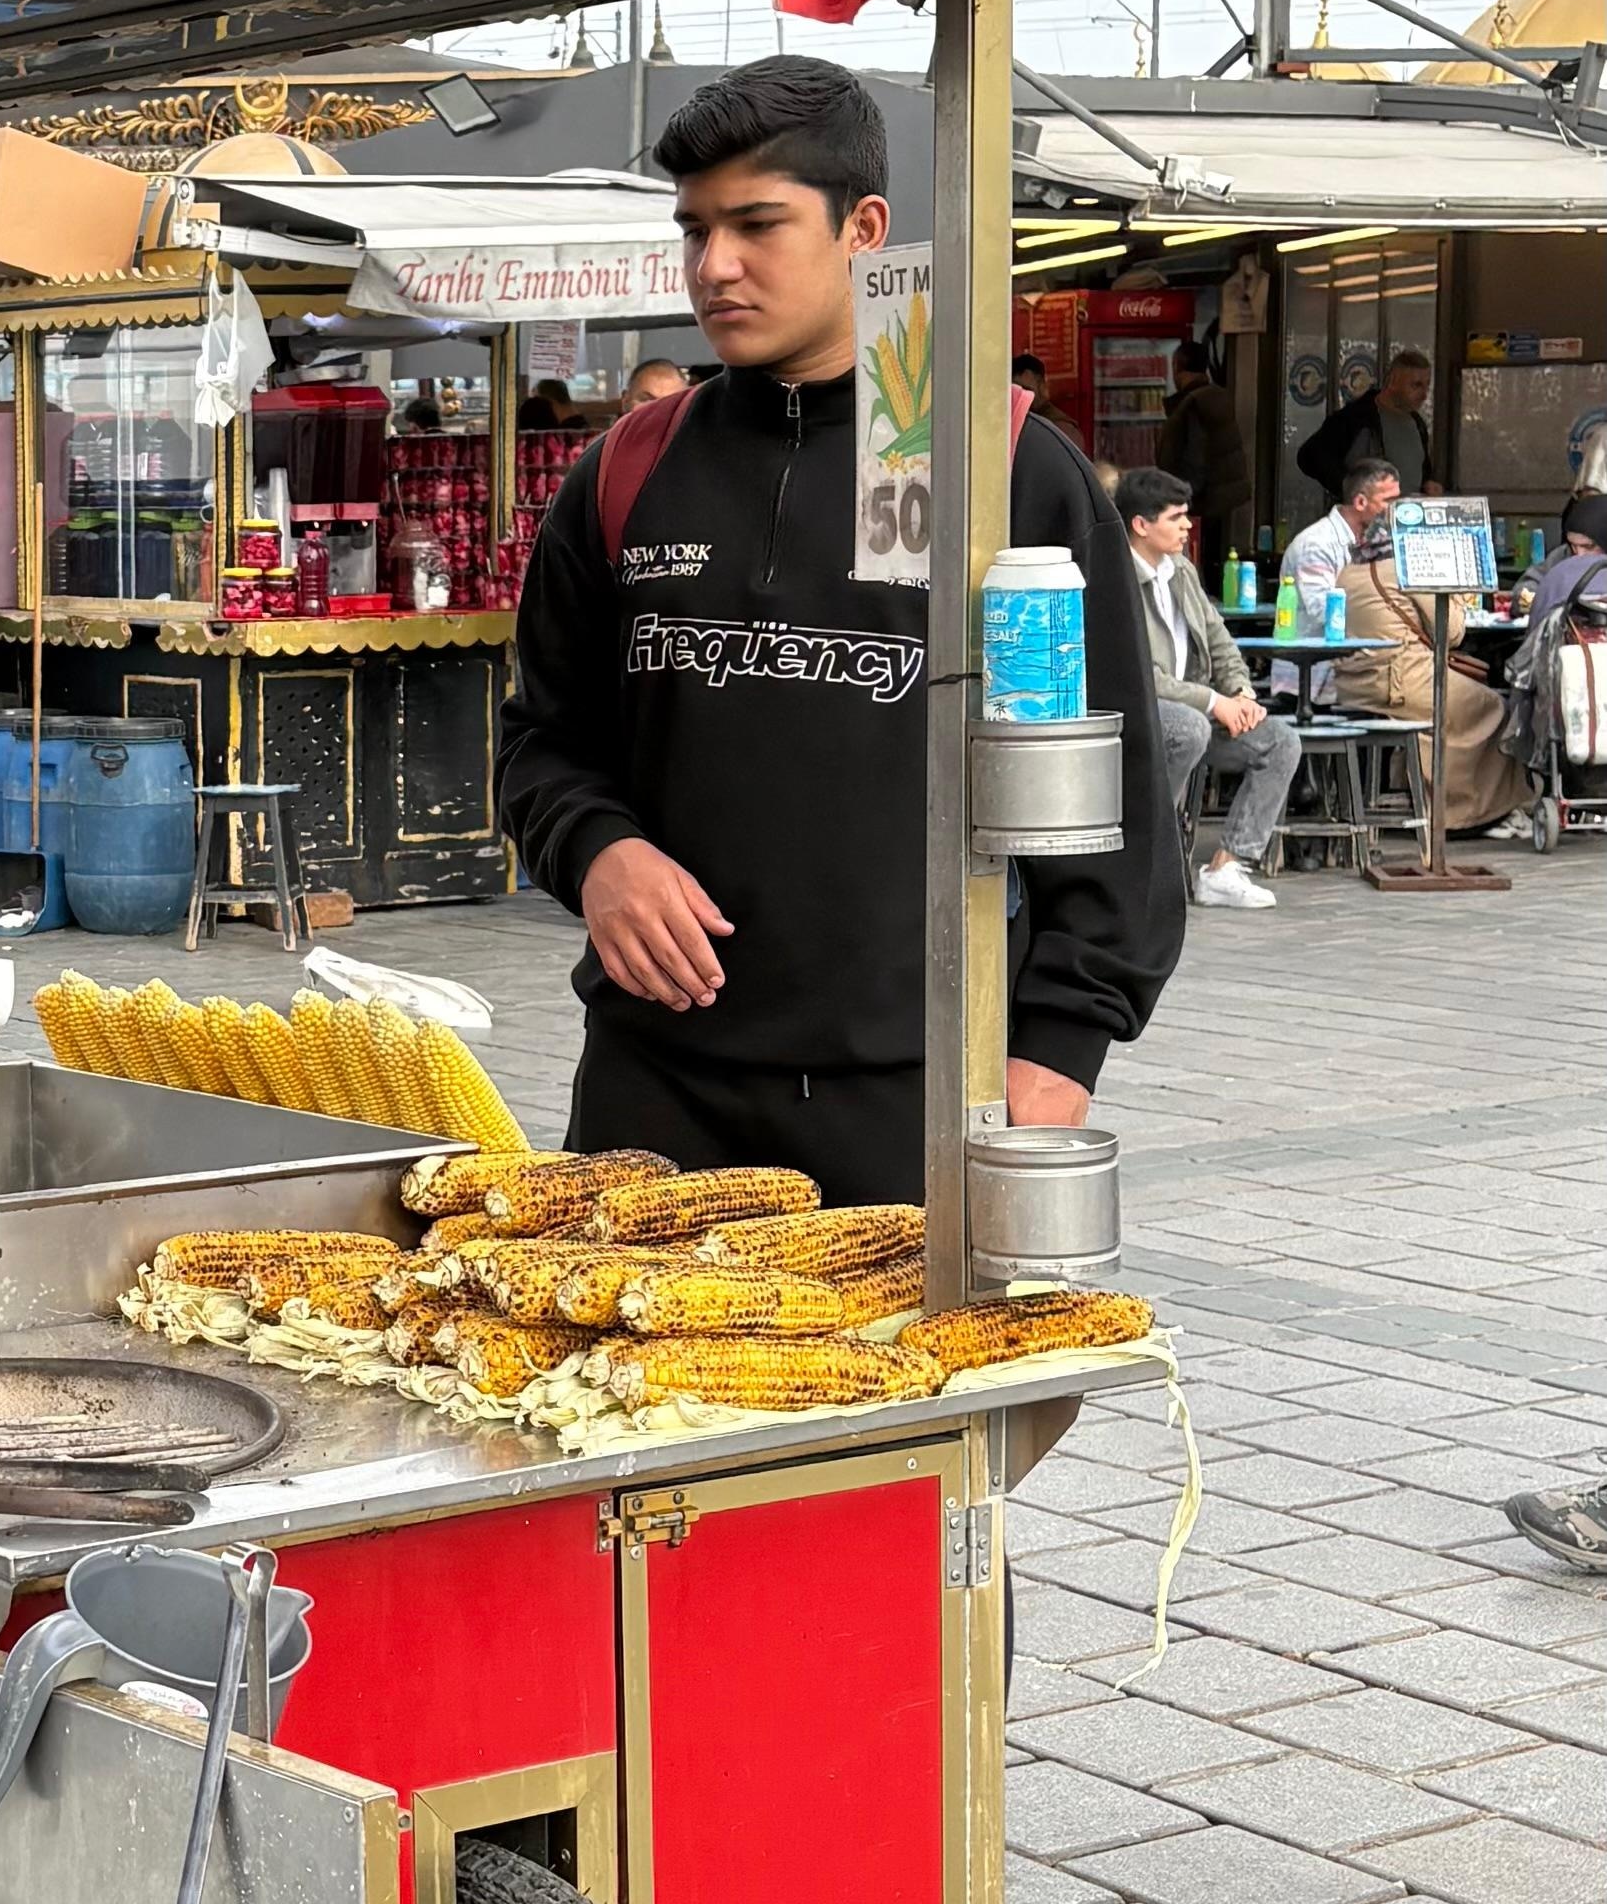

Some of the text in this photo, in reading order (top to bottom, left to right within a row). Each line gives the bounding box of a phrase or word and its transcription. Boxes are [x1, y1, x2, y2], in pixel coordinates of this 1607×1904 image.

[395, 252, 485, 304] Tarihi
[497, 257, 632, 301] Emmönü
[867, 264, 930, 298] SÜT M
[868, 483, 931, 555] 50
[623, 544, 713, 566] NEW YORK
[671, 562, 703, 576] 1987
[627, 613, 925, 703] Frequency
